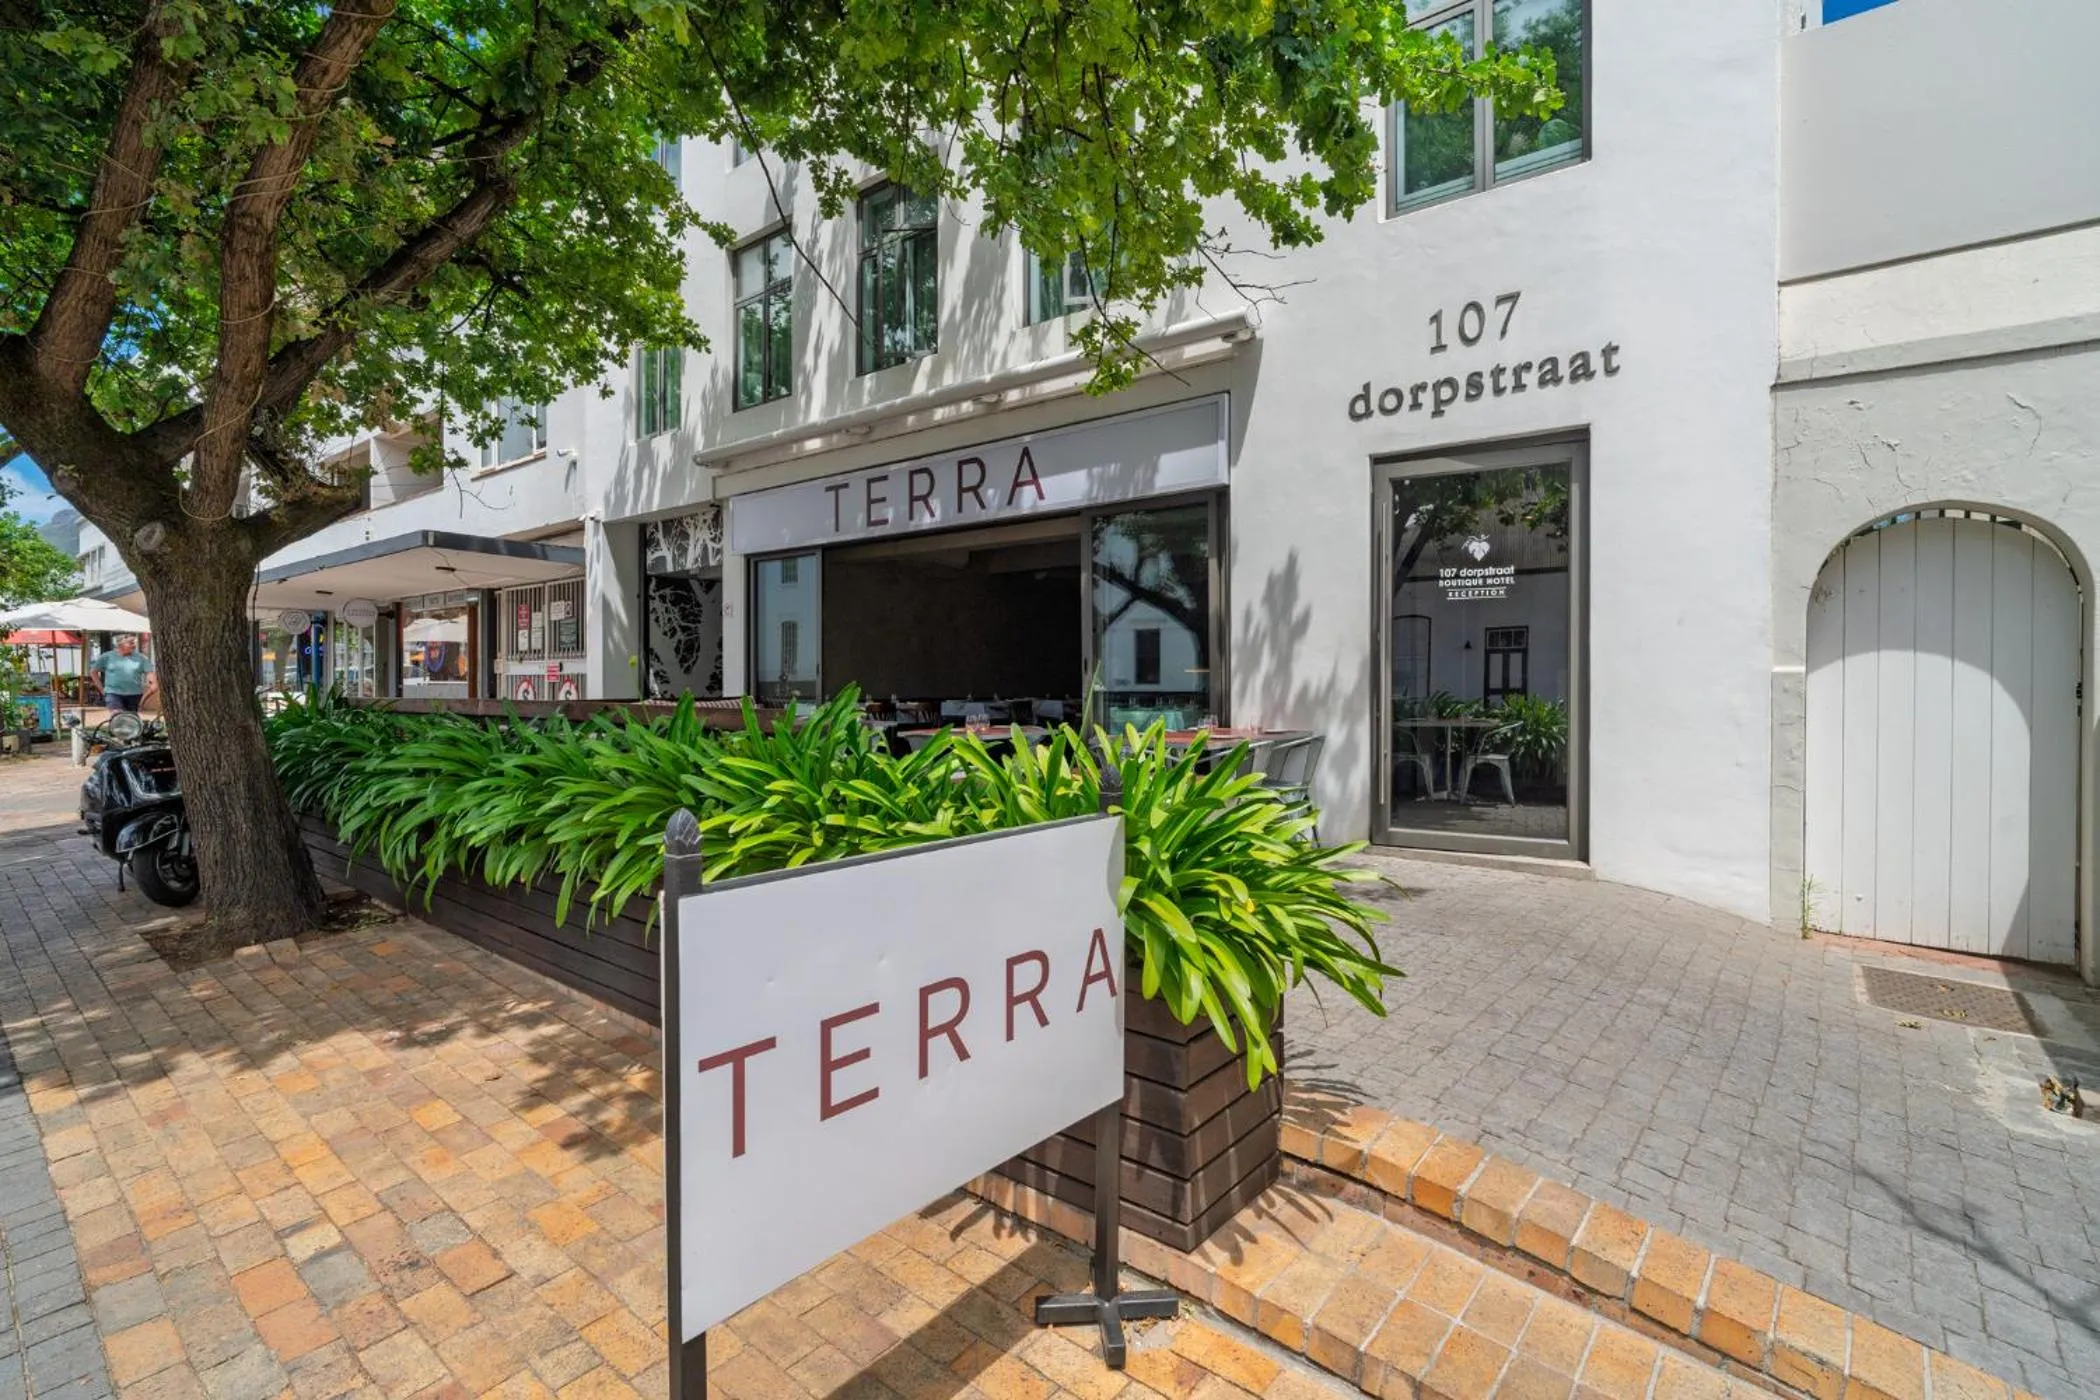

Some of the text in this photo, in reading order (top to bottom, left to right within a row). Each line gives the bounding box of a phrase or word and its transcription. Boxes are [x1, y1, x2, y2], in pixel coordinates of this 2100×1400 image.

[1428, 291, 1521, 355] 107
[1348, 340, 1621, 422] dorpstraat
[824, 446, 1045, 533] TERRA
[1438, 576, 1516, 587] BOUTIQUE HOTEL
[1439, 565, 1514, 578] 107 dorpstraat
[697, 927, 1118, 1158] TERRA
